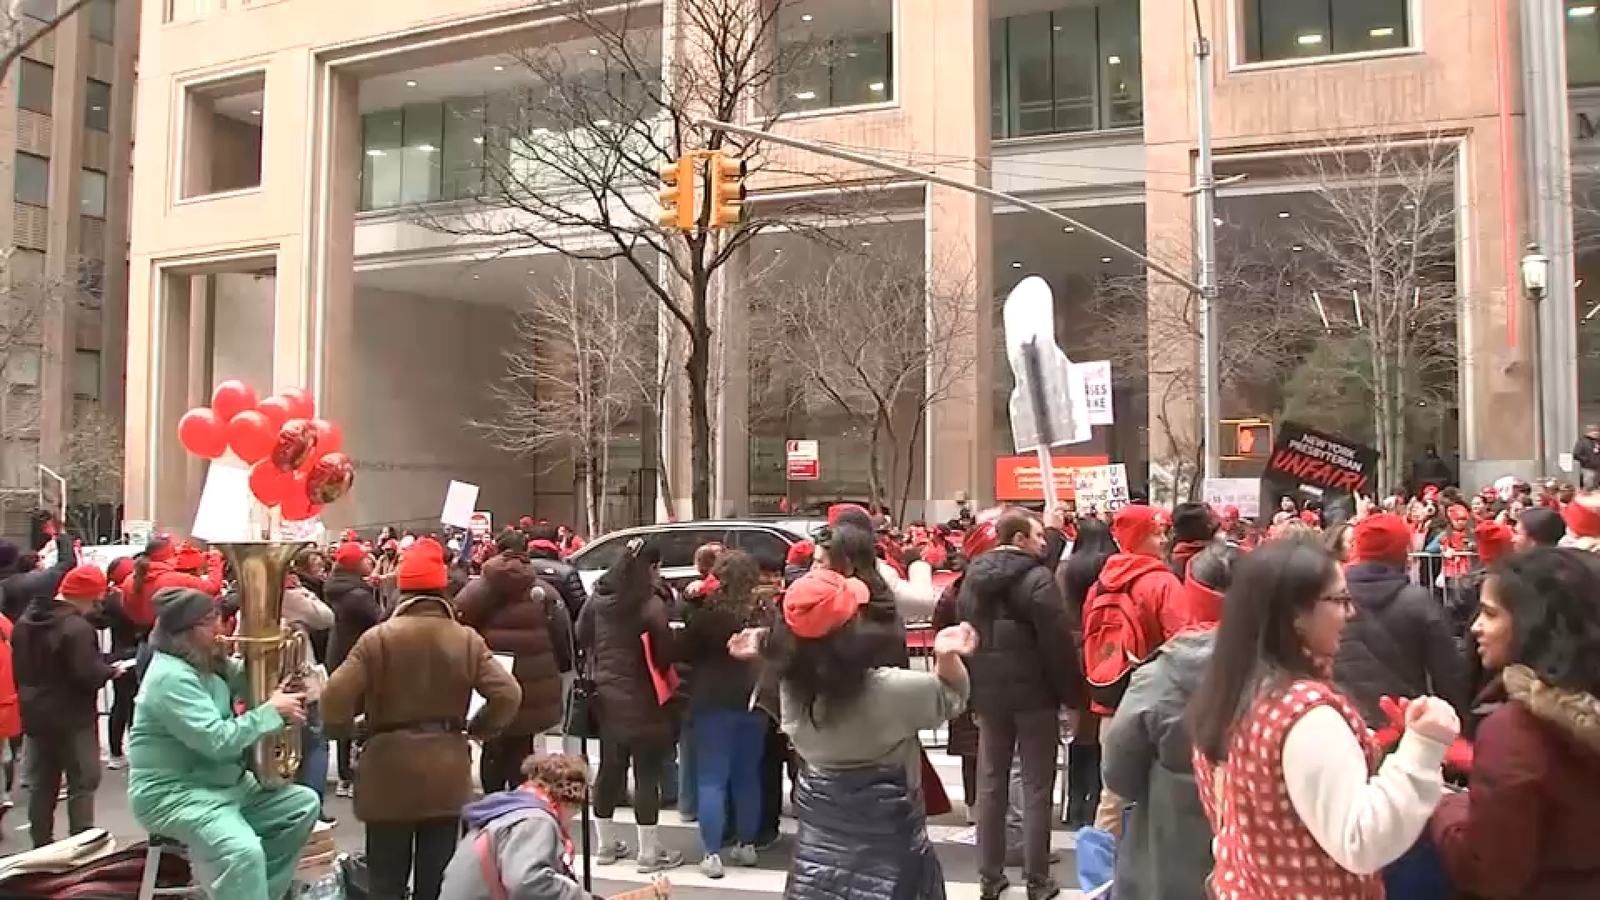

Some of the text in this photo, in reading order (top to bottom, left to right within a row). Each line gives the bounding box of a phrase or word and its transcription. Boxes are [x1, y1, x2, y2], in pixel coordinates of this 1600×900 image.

[1288, 439, 1363, 472] PRESBYTERIAN
[1301, 433, 1357, 459] NEW YORK
